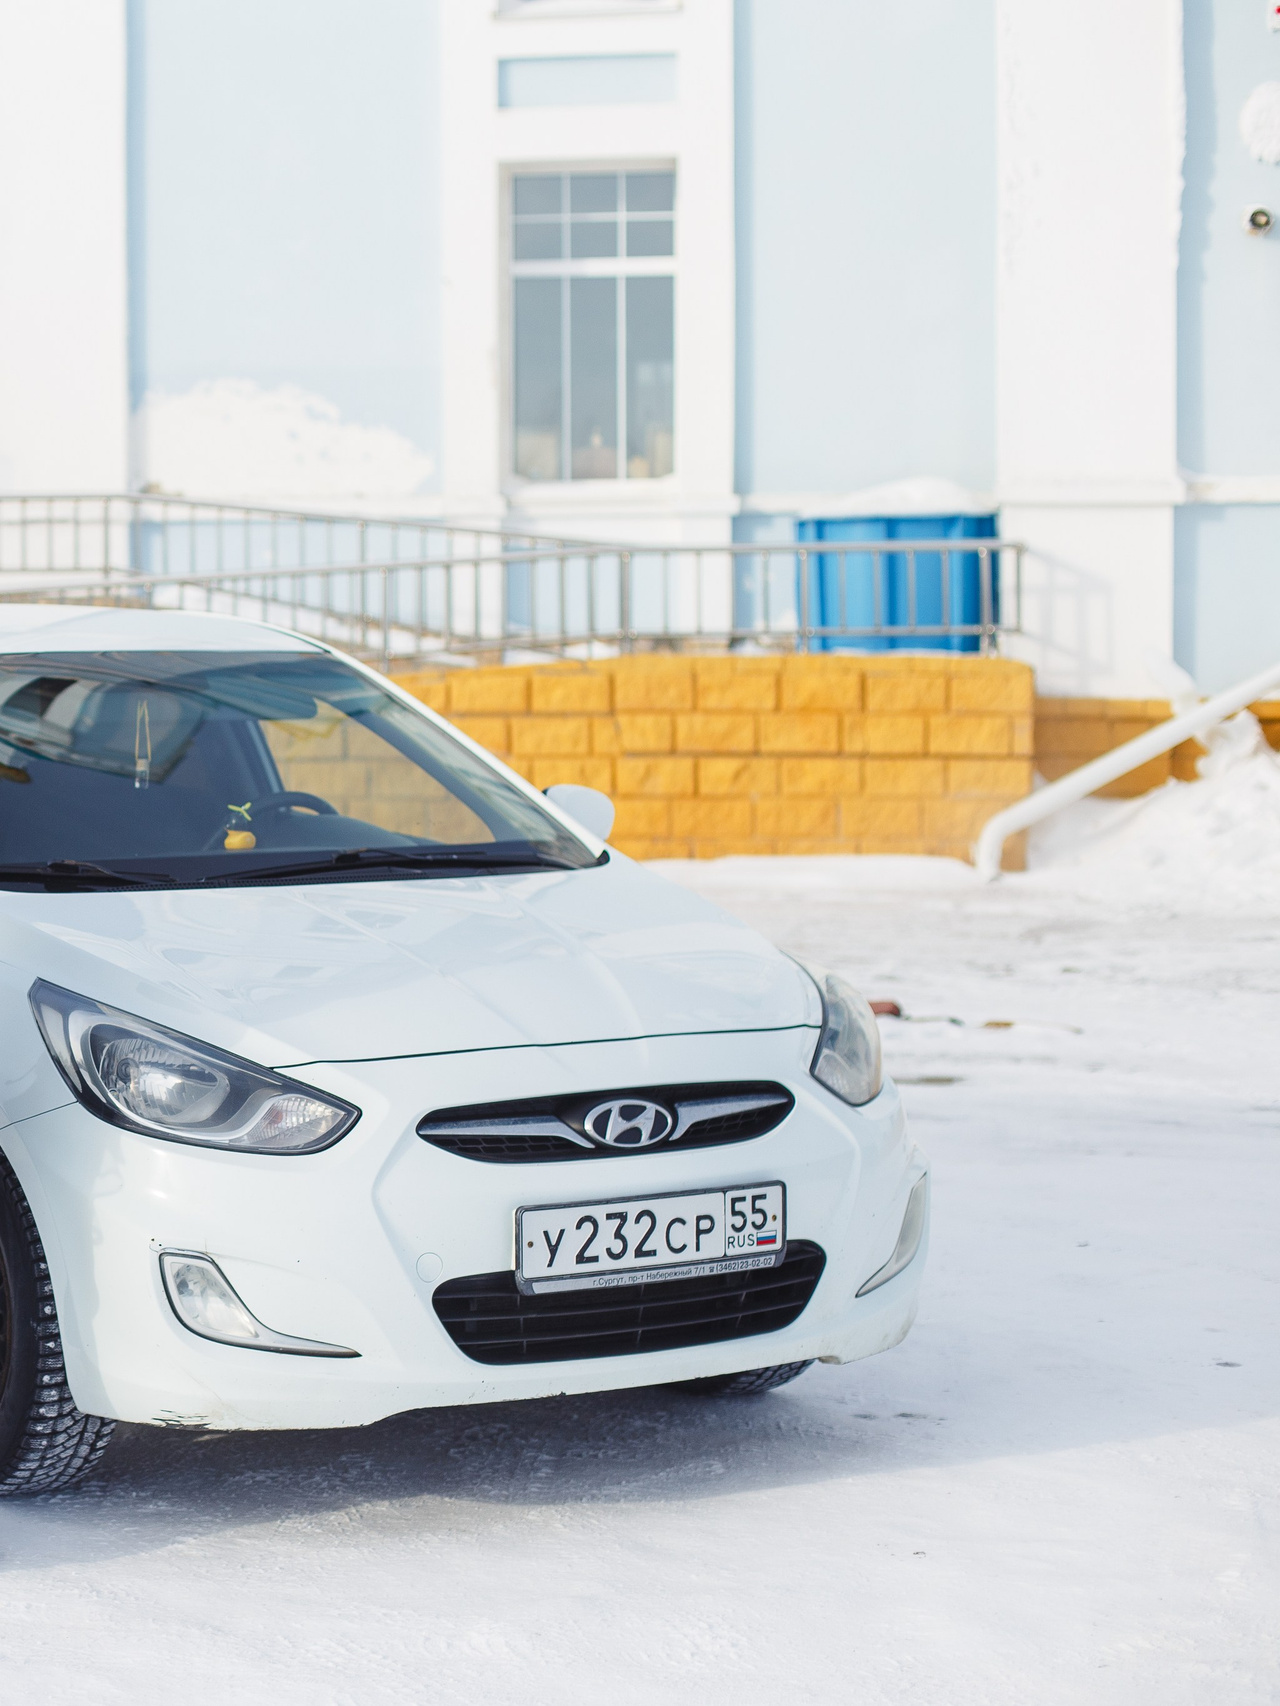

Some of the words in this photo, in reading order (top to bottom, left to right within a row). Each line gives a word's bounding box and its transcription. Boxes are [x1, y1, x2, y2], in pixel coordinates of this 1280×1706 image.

[730, 1194, 768, 1233] 55
[727, 1234, 755, 1250] RUS
[646, 1268, 692, 1281] Набережный
[694, 1266, 706, 1275] 7/1
